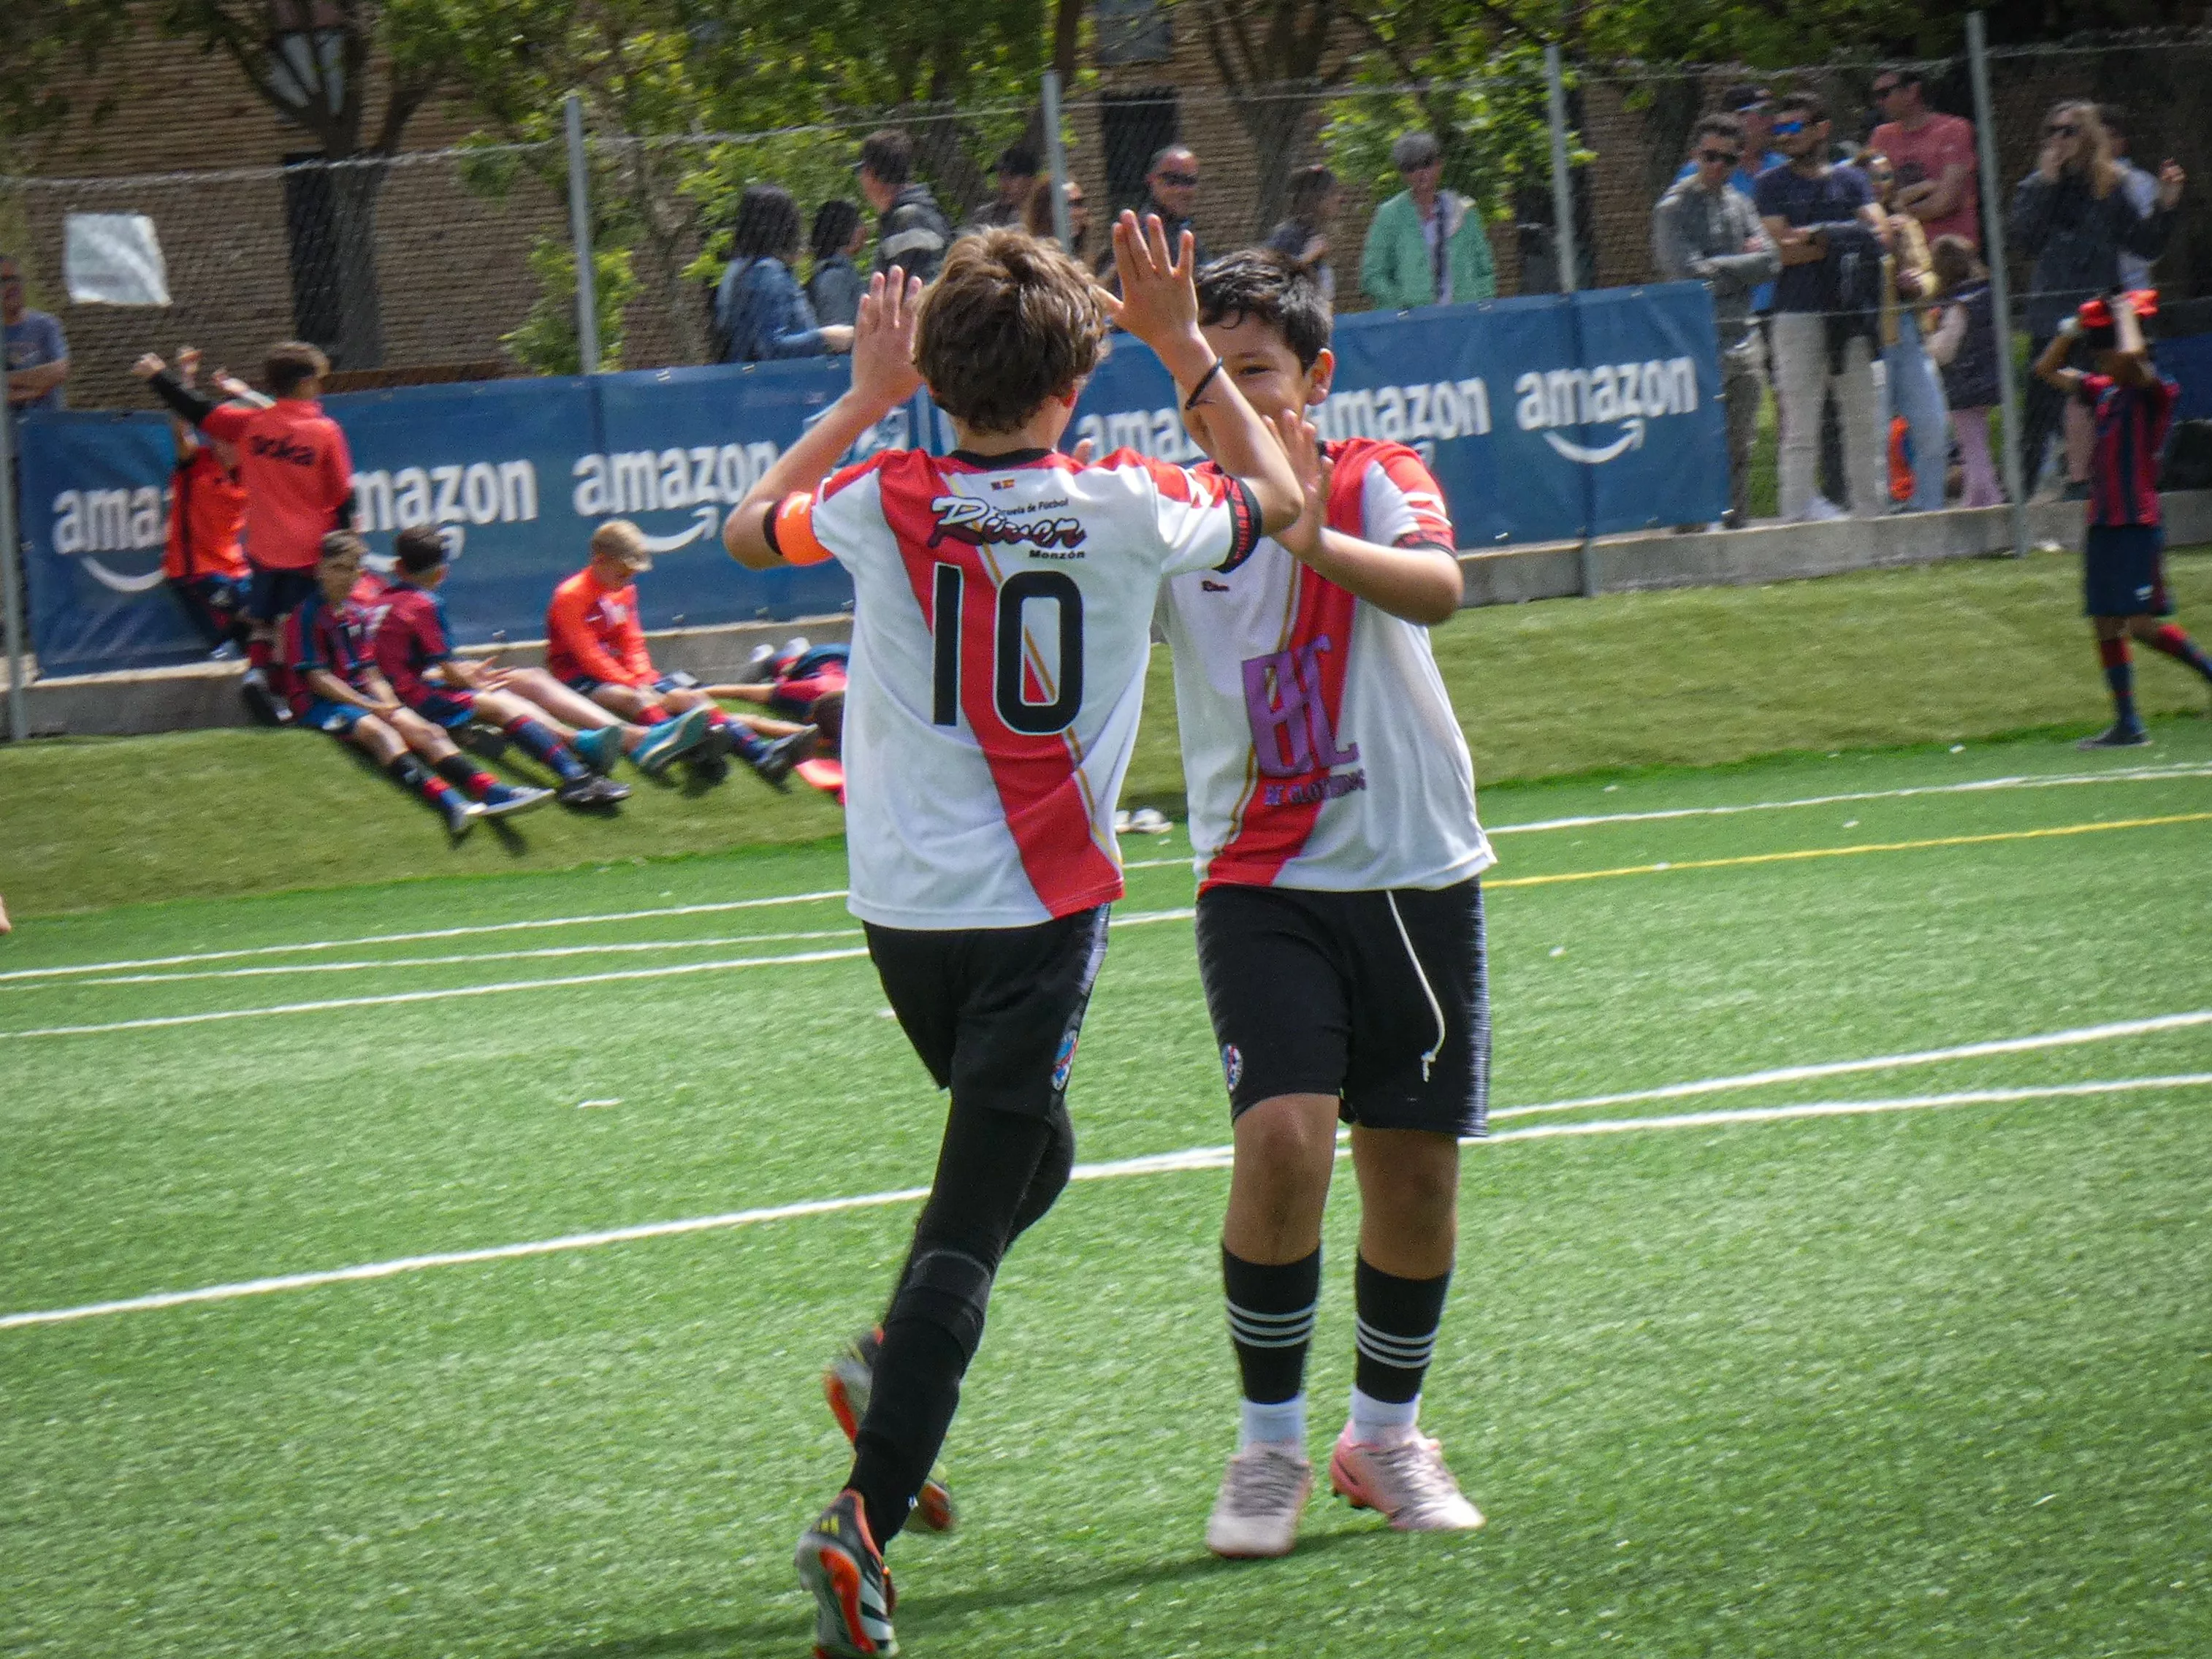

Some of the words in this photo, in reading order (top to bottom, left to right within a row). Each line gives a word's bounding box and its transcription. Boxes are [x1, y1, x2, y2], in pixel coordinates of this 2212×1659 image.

[1514, 356, 1698, 430] amazon
[1077, 408, 1208, 462] ama
[53, 486, 173, 554] ama
[349, 459, 539, 533] mazon
[1029, 549, 1086, 560] Monzón
[933, 562, 1084, 734] 10
